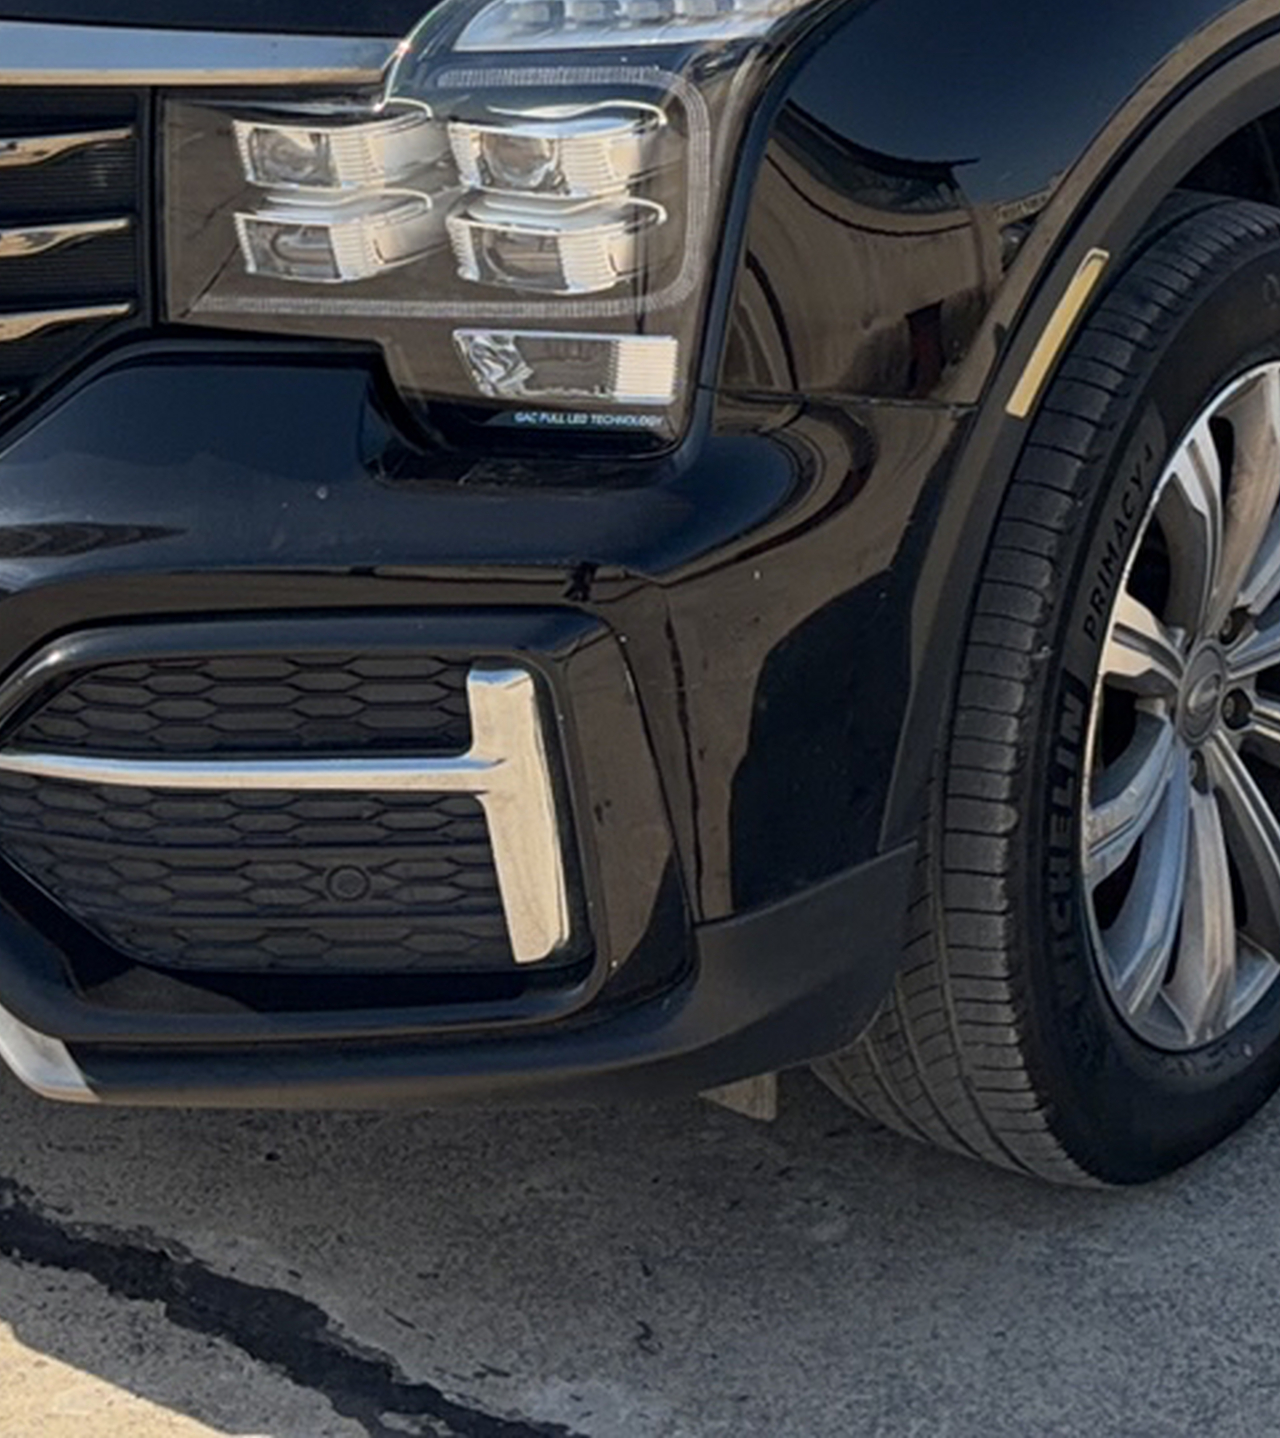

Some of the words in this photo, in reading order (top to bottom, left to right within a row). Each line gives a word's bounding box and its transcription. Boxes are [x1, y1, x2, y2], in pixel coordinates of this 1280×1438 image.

[514, 412, 537, 424] GAC
[539, 412, 566, 425] FULL
[567, 413, 587, 425] LED
[591, 414, 665, 428] TECHNOLOGY
[1083, 463, 1144, 642] PRIMACY
